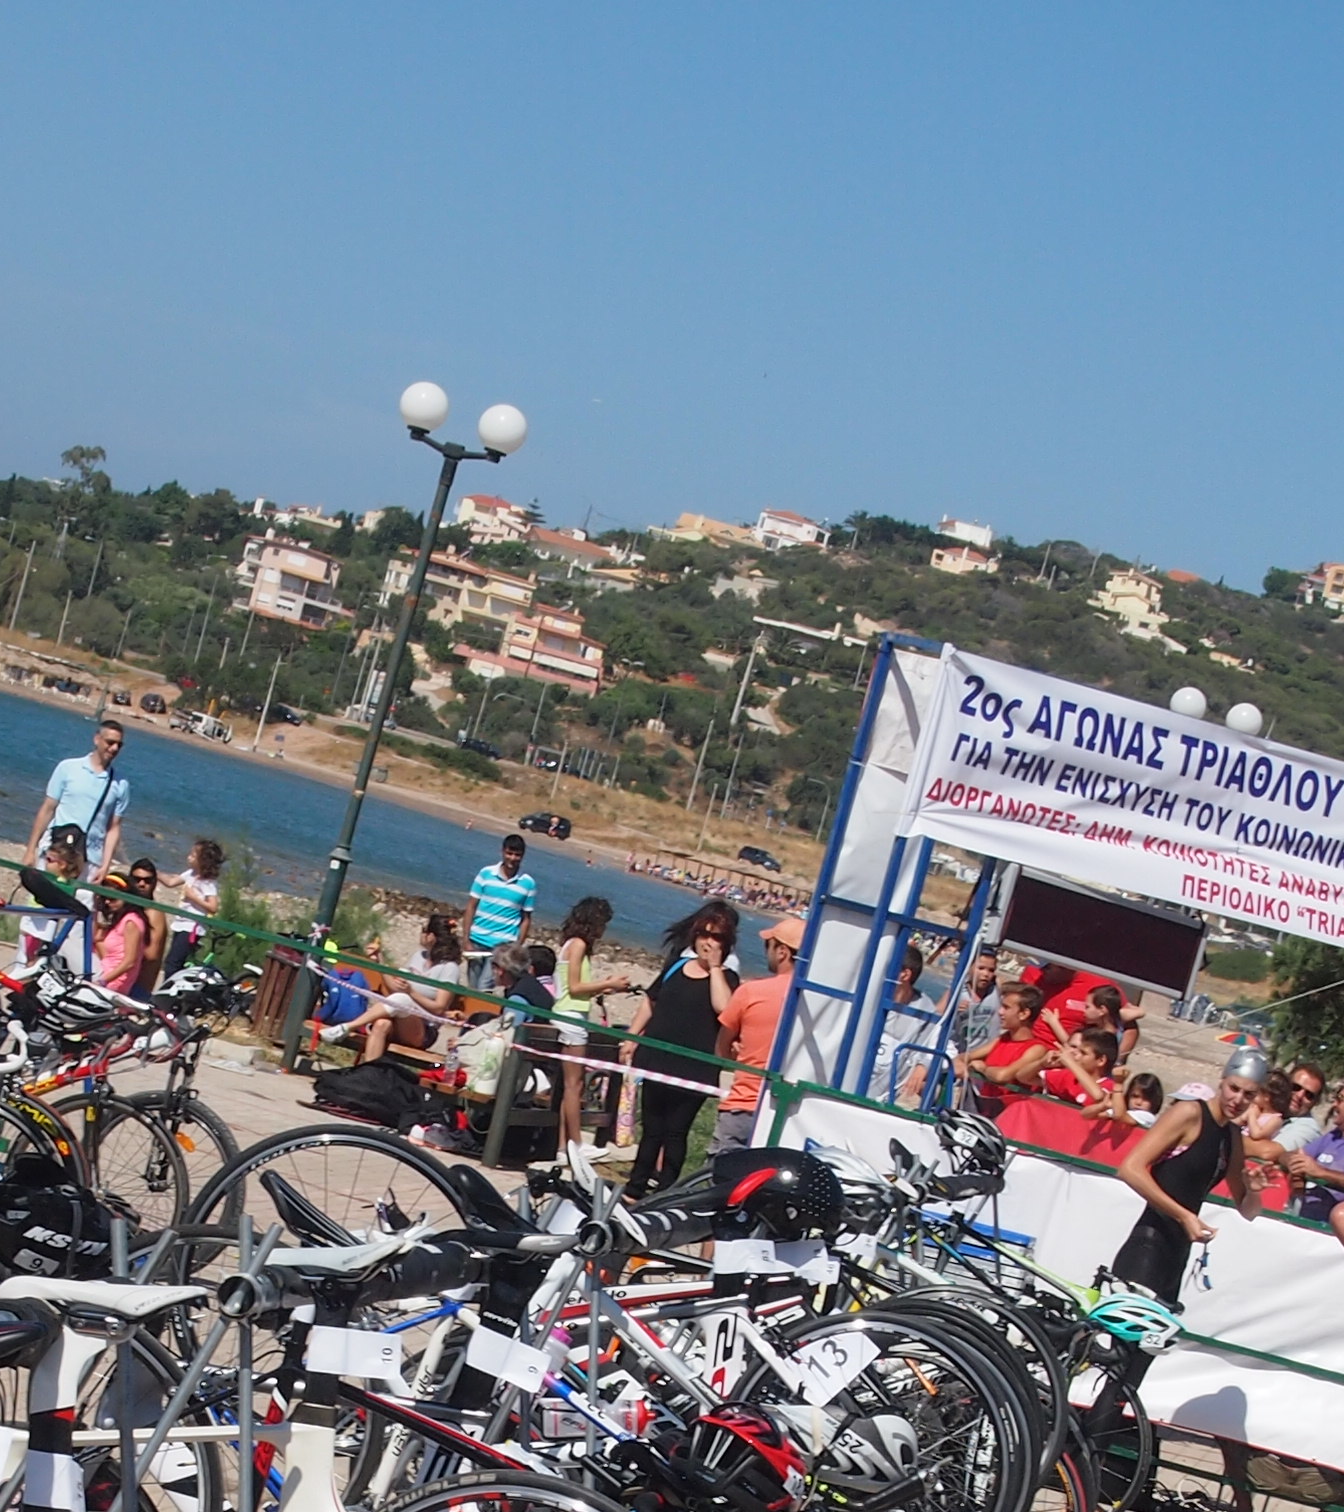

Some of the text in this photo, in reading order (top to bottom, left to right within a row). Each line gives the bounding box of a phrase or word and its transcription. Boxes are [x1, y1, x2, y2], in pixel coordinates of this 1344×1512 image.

[959, 675, 1023, 738] 2ος
[1027, 695, 1170, 770] ΑΓΩΝΑΣ
[951, 733, 992, 771] ΓΙΑ
[999, 746, 1055, 787] ΤΗΝ
[1055, 763, 1179, 821] ΕΝΙΣΧΥΣΗ
[1184, 798, 1232, 840] ΤΟΥ
[1181, 874, 1290, 923] ΠΕΡΙΟΔΙΚΟ
[806, 1339, 848, 1379] 13
